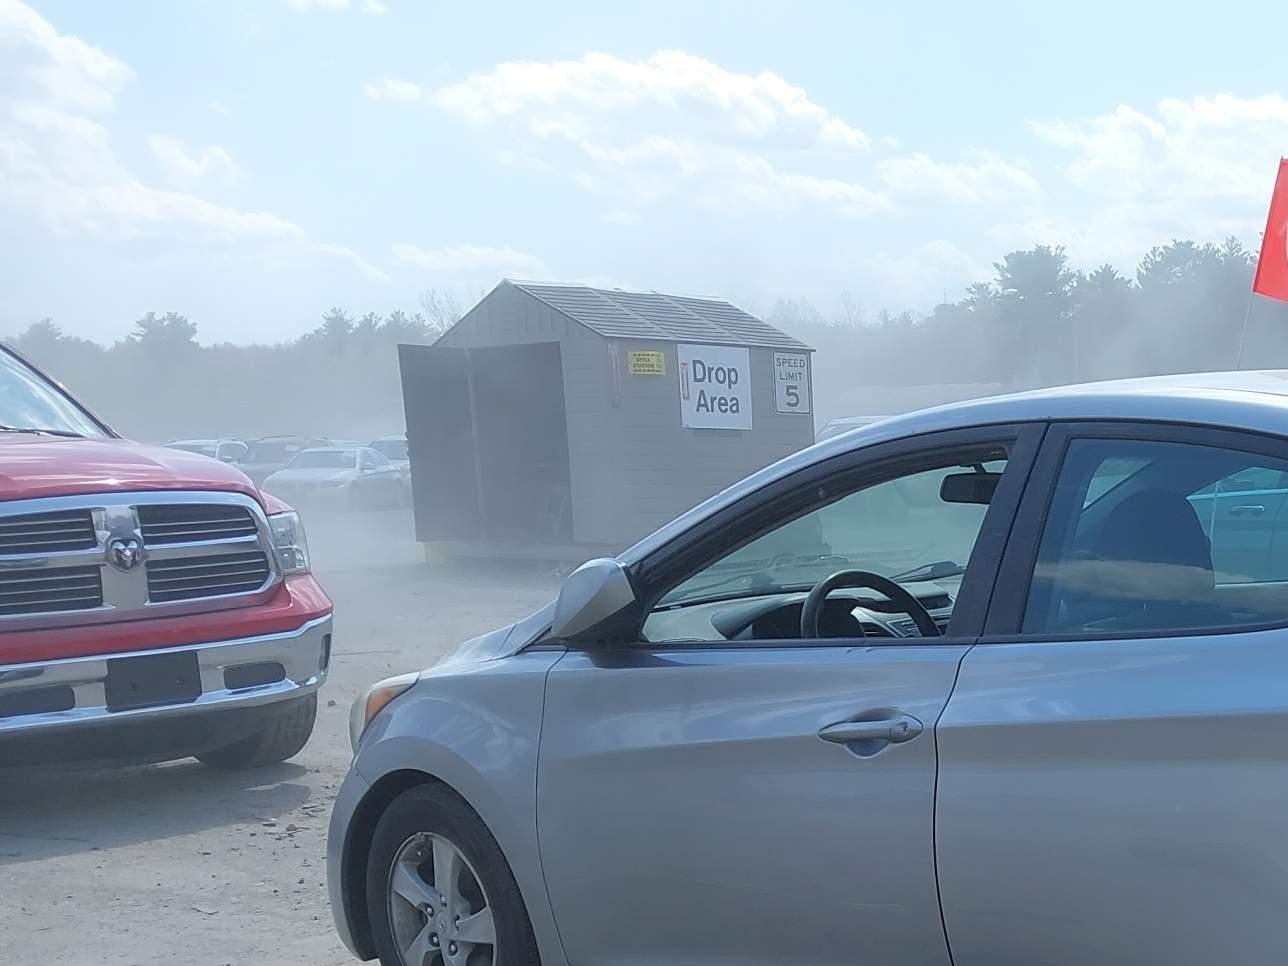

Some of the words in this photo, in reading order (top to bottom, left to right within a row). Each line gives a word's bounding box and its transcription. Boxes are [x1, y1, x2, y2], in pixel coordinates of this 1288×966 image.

[691, 359, 739, 390] Drop
[775, 357, 806, 369] SPEED
[779, 371, 803, 382] LIMIT
[695, 389, 740, 414] Area
[785, 384, 800, 408] 5
